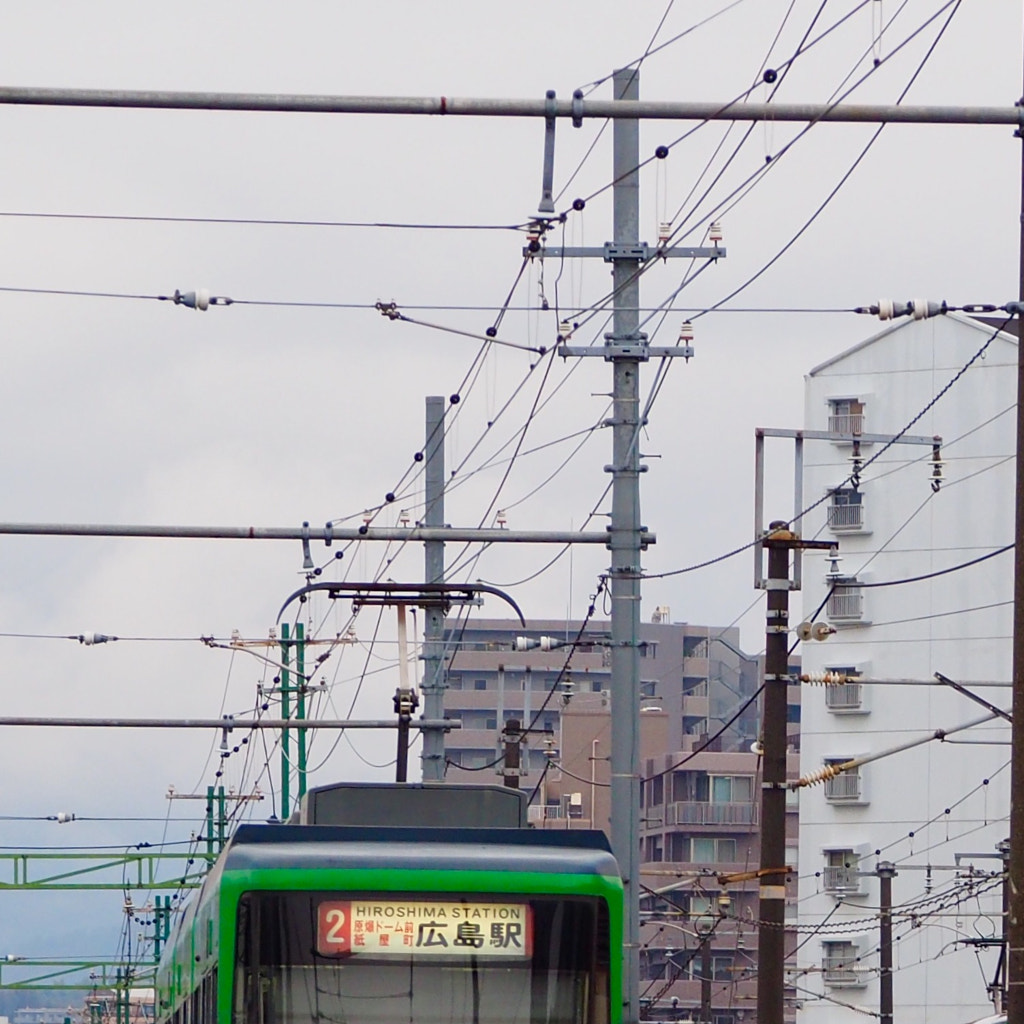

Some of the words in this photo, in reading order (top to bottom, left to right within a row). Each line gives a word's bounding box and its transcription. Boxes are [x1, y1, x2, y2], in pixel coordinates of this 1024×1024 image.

[356, 906, 447, 918] HIROSHIMA
[452, 907, 521, 919] STATION
[325, 909, 345, 943] 2
[353, 920, 414, 934] 原爆ドーム前
[415, 921, 522, 948] 広島駅
